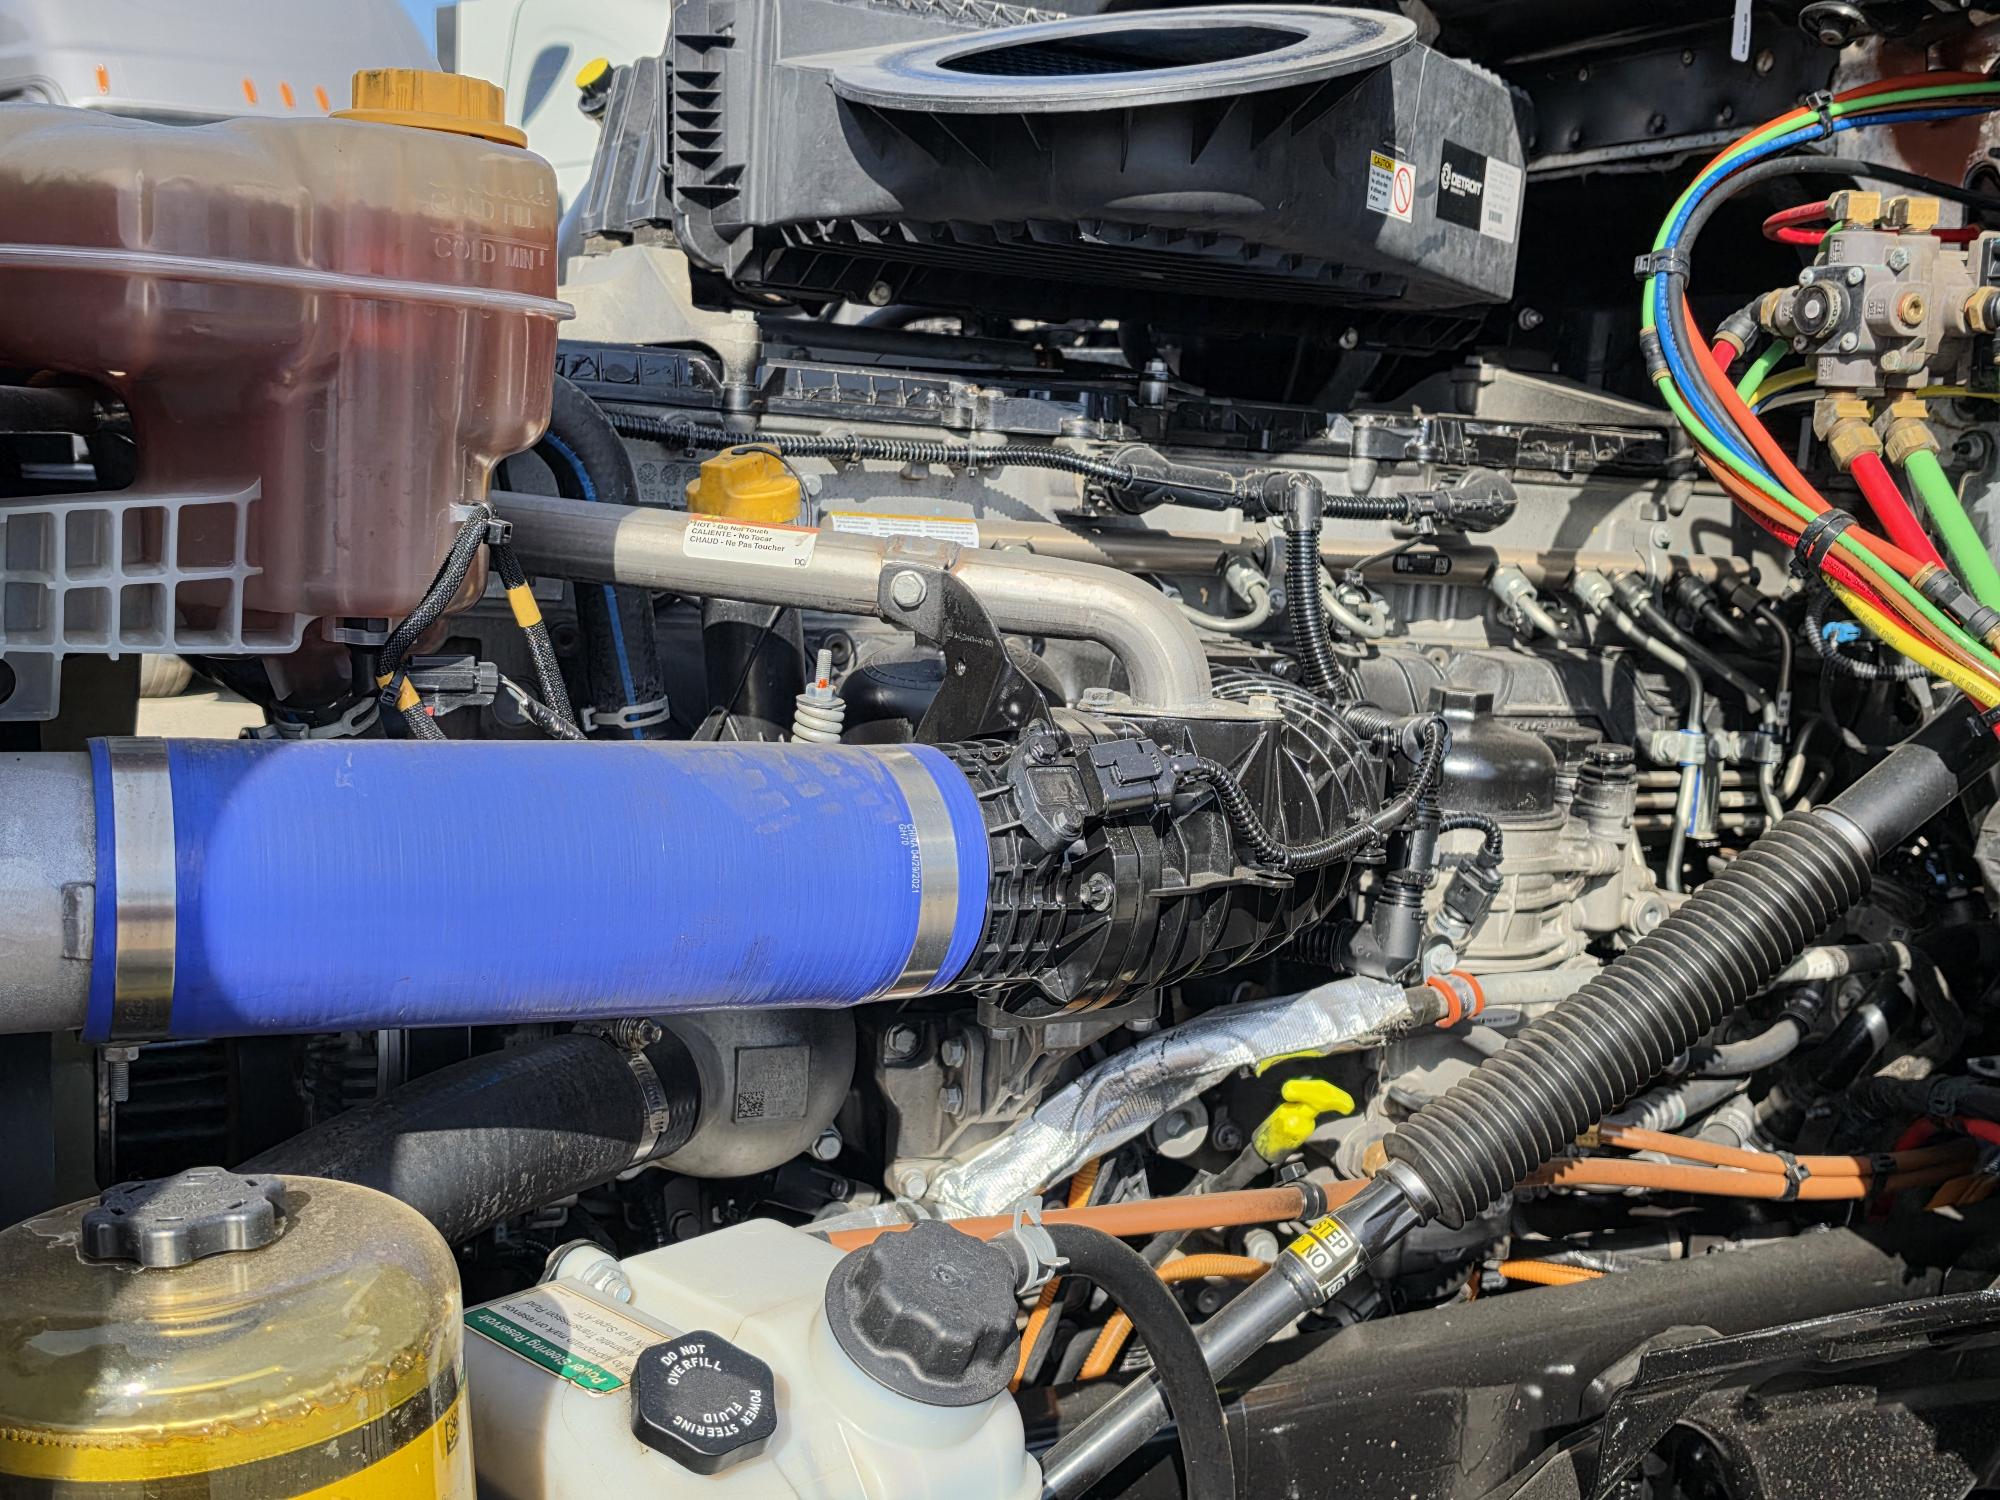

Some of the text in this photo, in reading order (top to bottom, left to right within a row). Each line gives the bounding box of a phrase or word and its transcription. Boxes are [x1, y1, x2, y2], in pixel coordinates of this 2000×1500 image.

[1451, 172, 1482, 196] DETROIT
[435, 236, 534, 271] COLD MIN
[689, 536, 719, 545] CHAUD
[738, 541, 752, 549] Pas
[754, 543, 785, 552] Toucher
[691, 528, 731, 538] CALIENTE
[751, 534, 773, 542] Tocar
[906, 823, 918, 848] CHINA
[1313, 1219, 1349, 1250] STEP
[1301, 1242, 1327, 1268] NO
[536, 1320, 549, 1331] on
[573, 1309, 597, 1323] ATF
[547, 1325, 568, 1342] mark
[477, 1314, 608, 1385] Power Steering Reservoir
[660, 1344, 706, 1367] DO NOT
[667, 1357, 722, 1386] OVERFILL
[673, 1389, 762, 1438] POWER STEERING
[703, 1401, 743, 1424] FLUID
